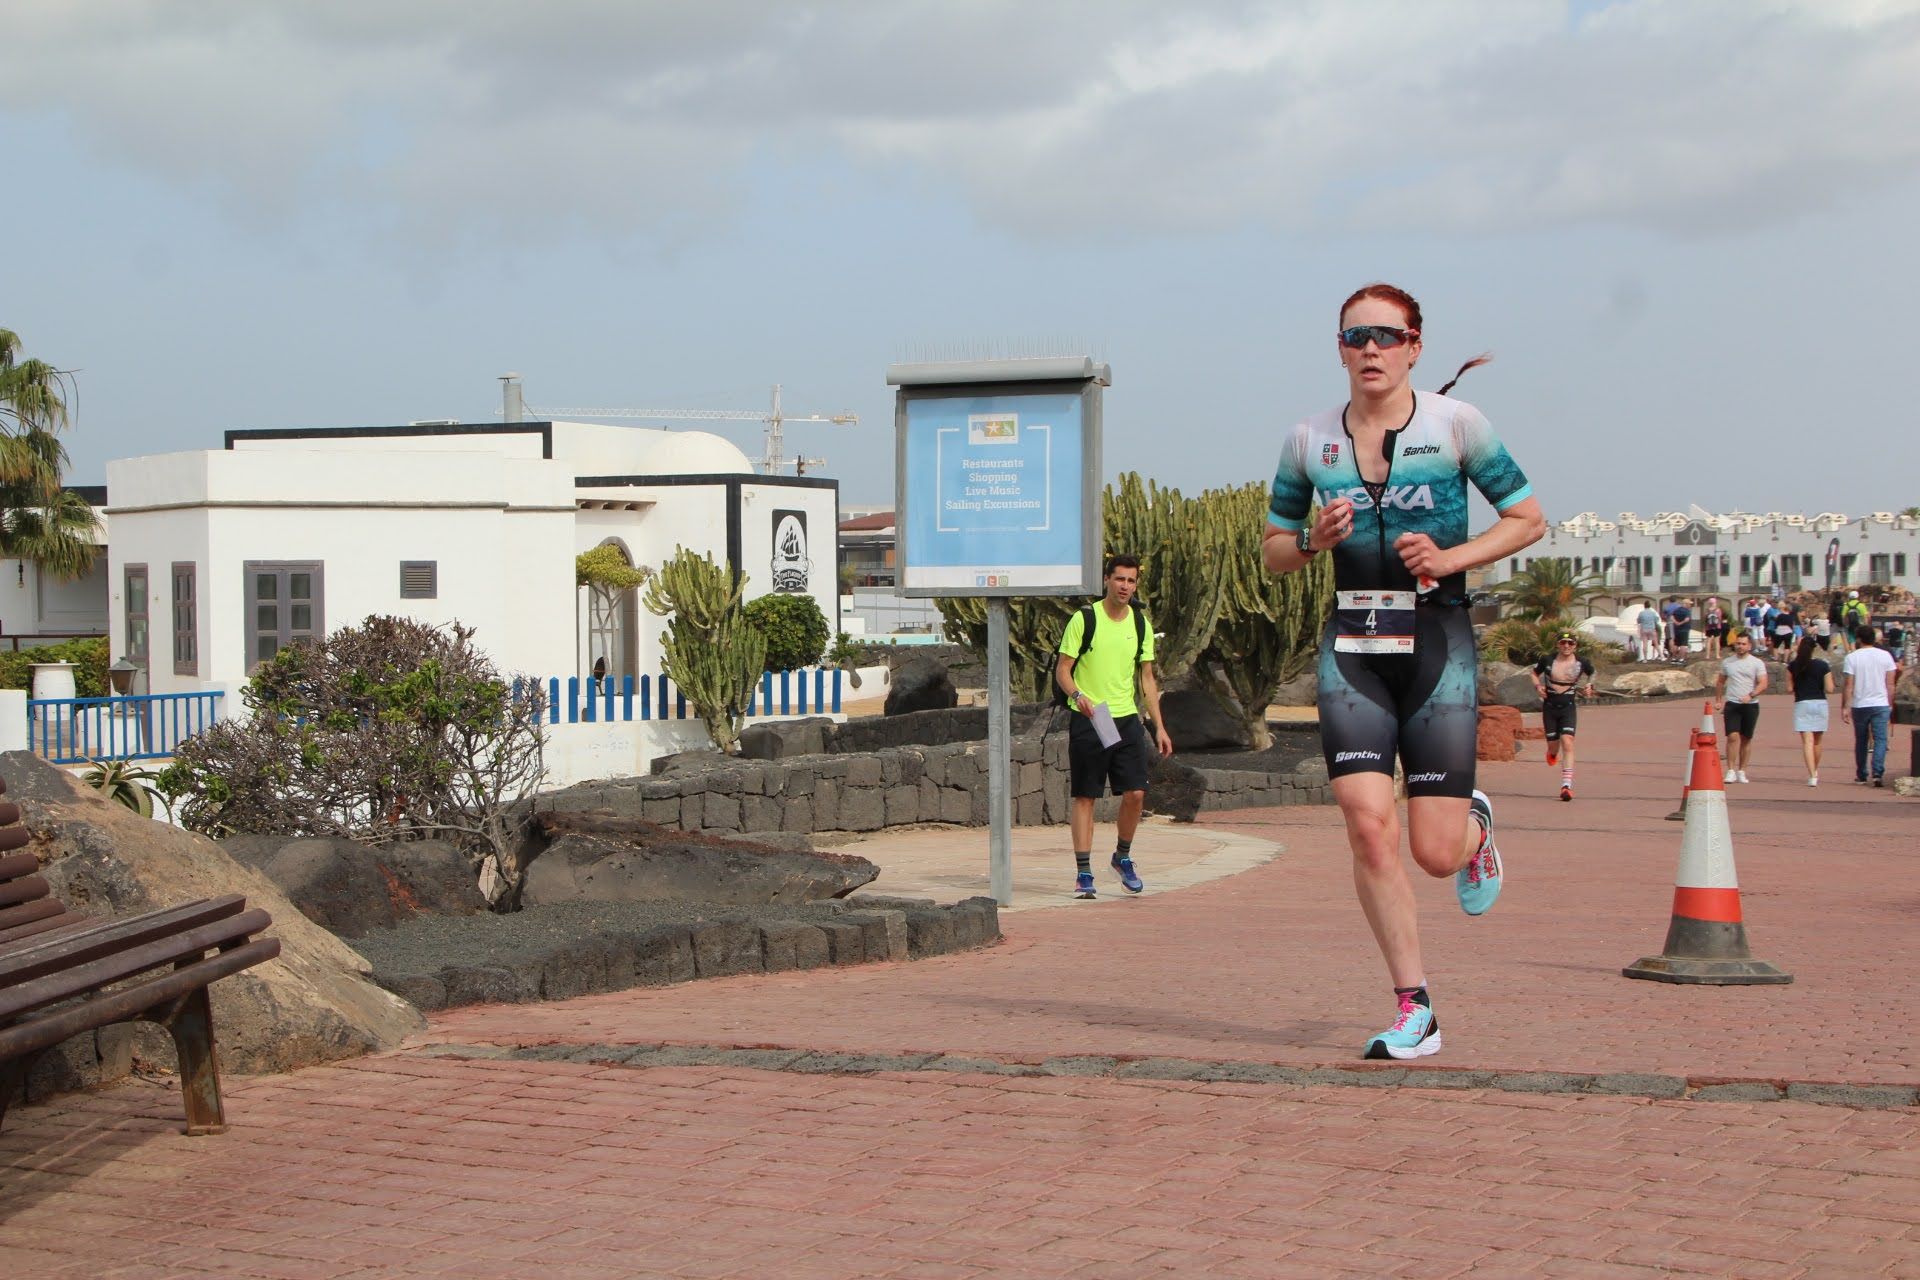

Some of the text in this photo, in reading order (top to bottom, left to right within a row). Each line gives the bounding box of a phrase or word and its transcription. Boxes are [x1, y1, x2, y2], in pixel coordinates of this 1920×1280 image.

[962, 459, 1024, 469] Restaurants
[968, 472, 1017, 484] Shopping
[965, 485, 1021, 496] Live Music
[945, 499, 1041, 512] Sailing Excursions
[1365, 609, 1377, 629] 4
